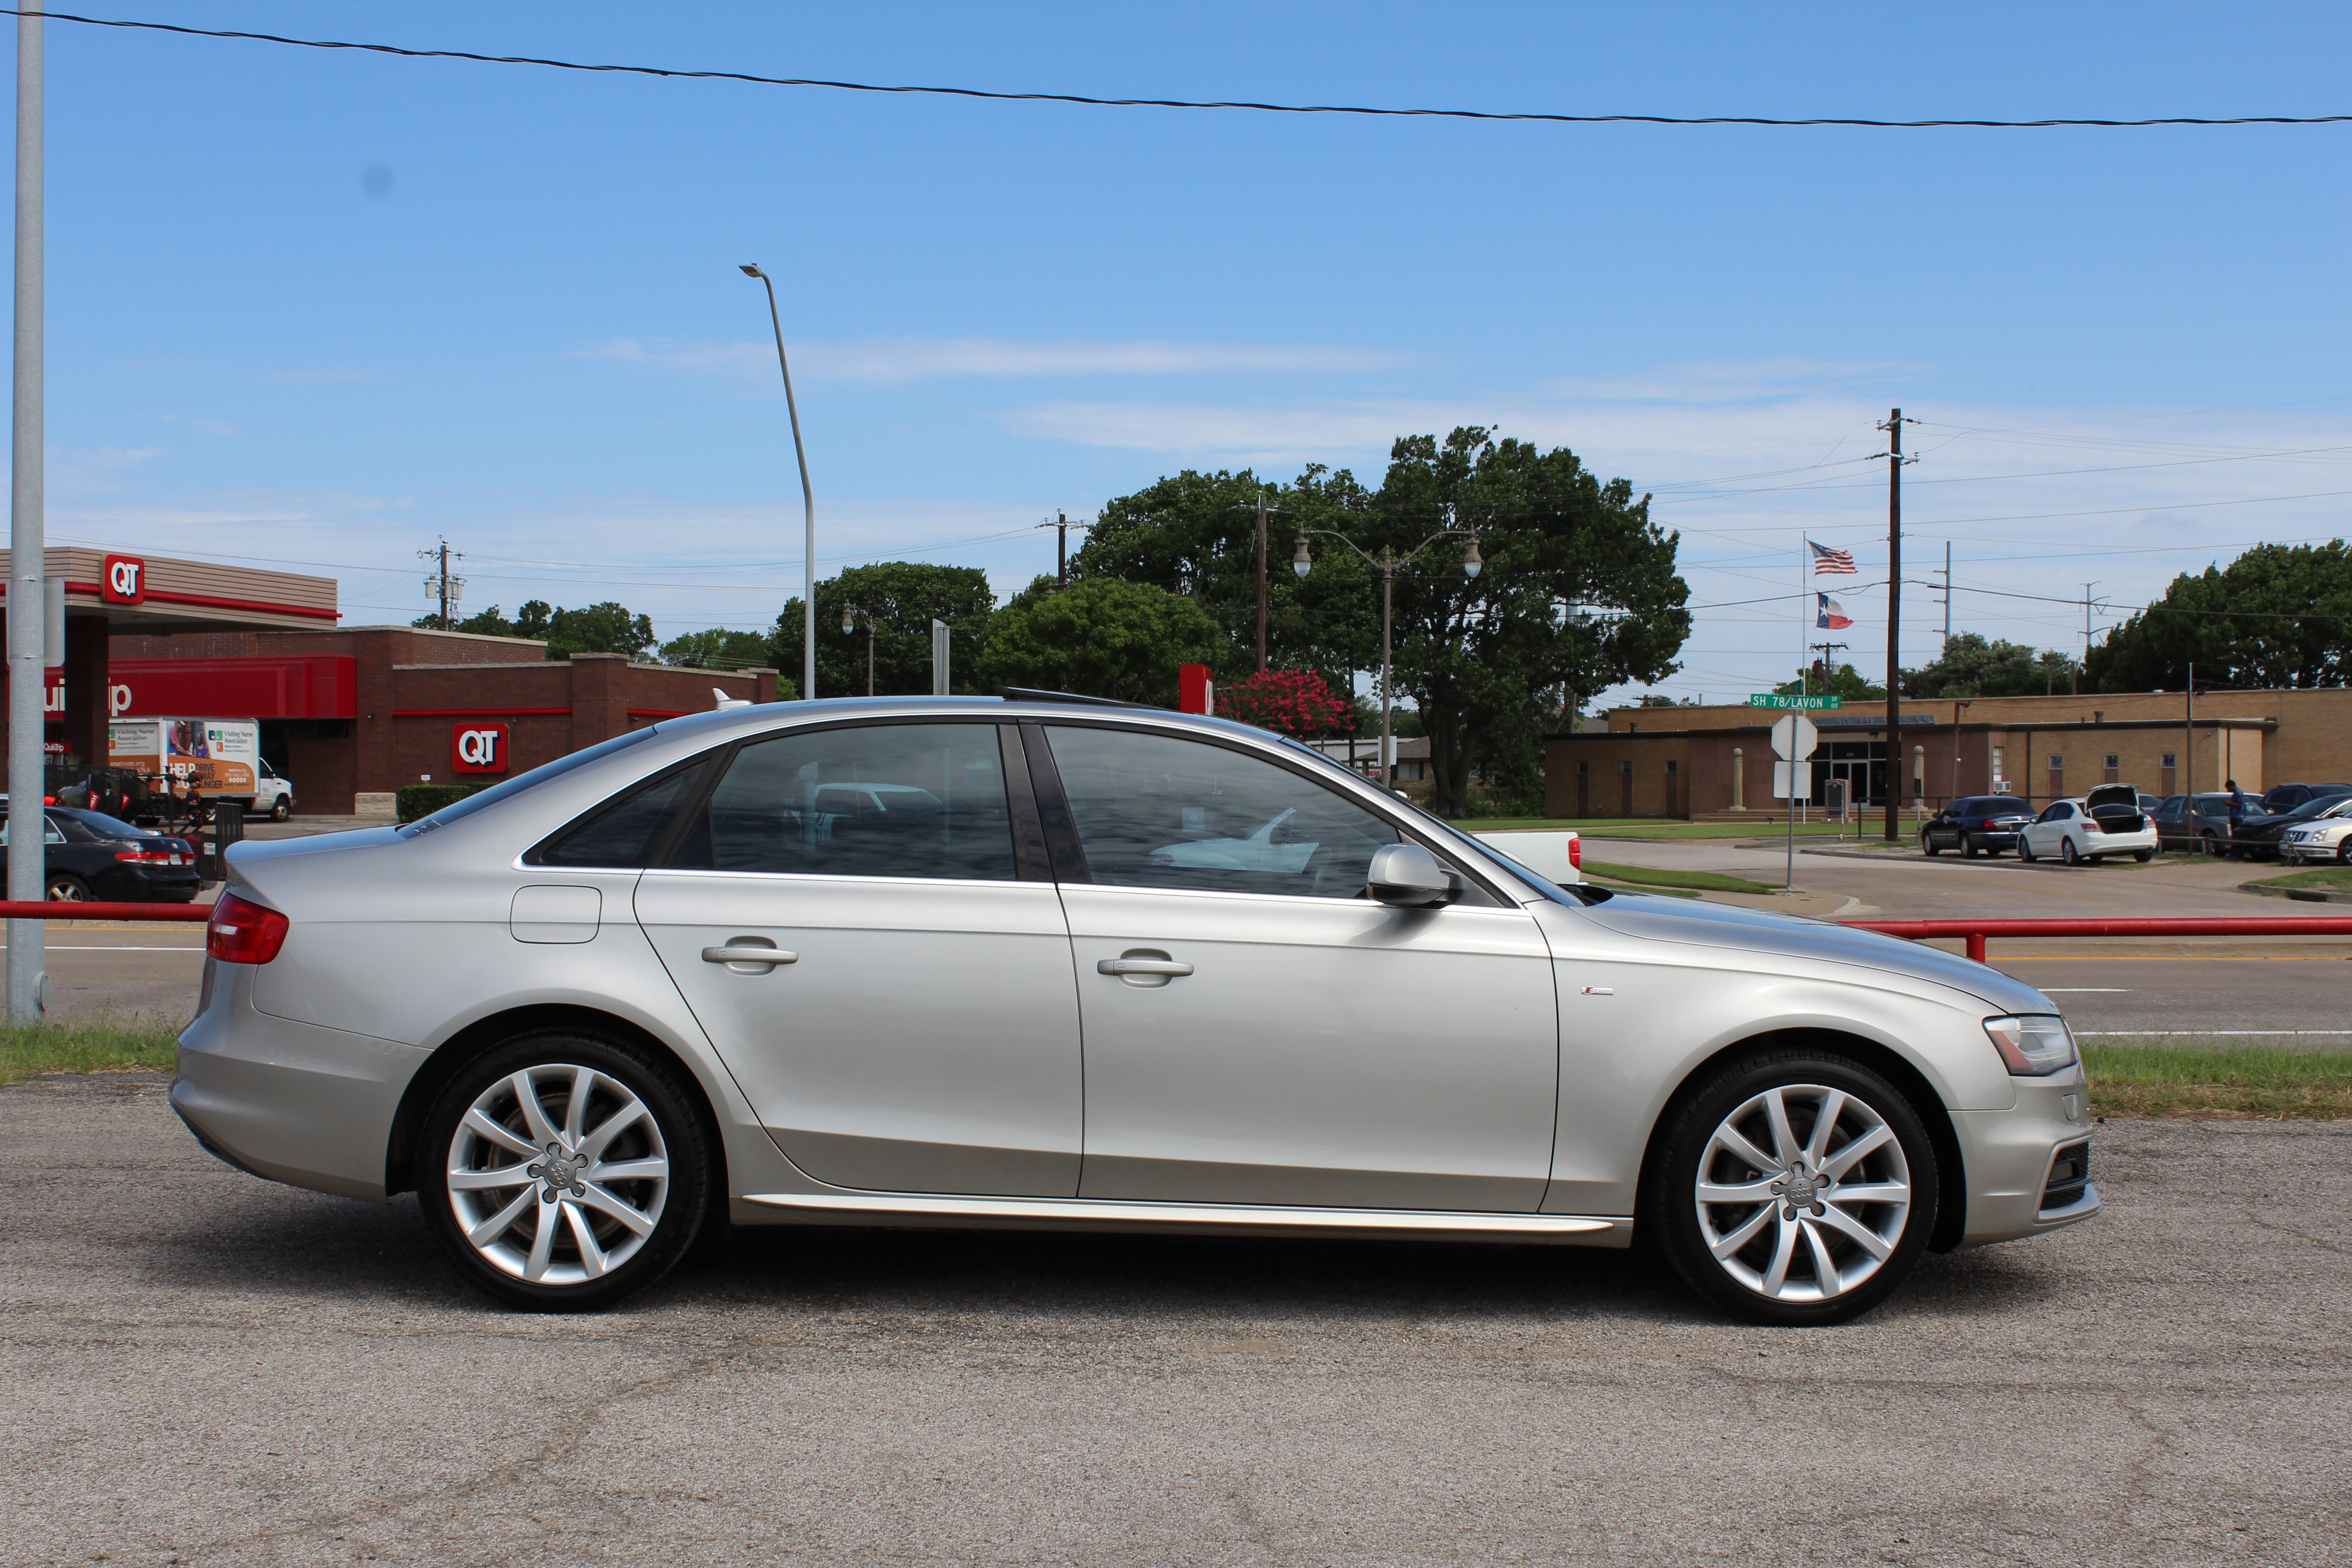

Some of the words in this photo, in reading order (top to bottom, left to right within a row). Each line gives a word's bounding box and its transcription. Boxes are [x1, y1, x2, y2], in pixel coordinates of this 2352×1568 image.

[111, 562, 139, 596] QT
[1753, 696, 1766, 706] SH
[1772, 696, 1823, 708] 78/LAVON
[224, 730, 240, 739] Visiting
[459, 730, 498, 765] QT
[170, 763, 196, 776] HELP
[196, 763, 215, 772] DRIVE
